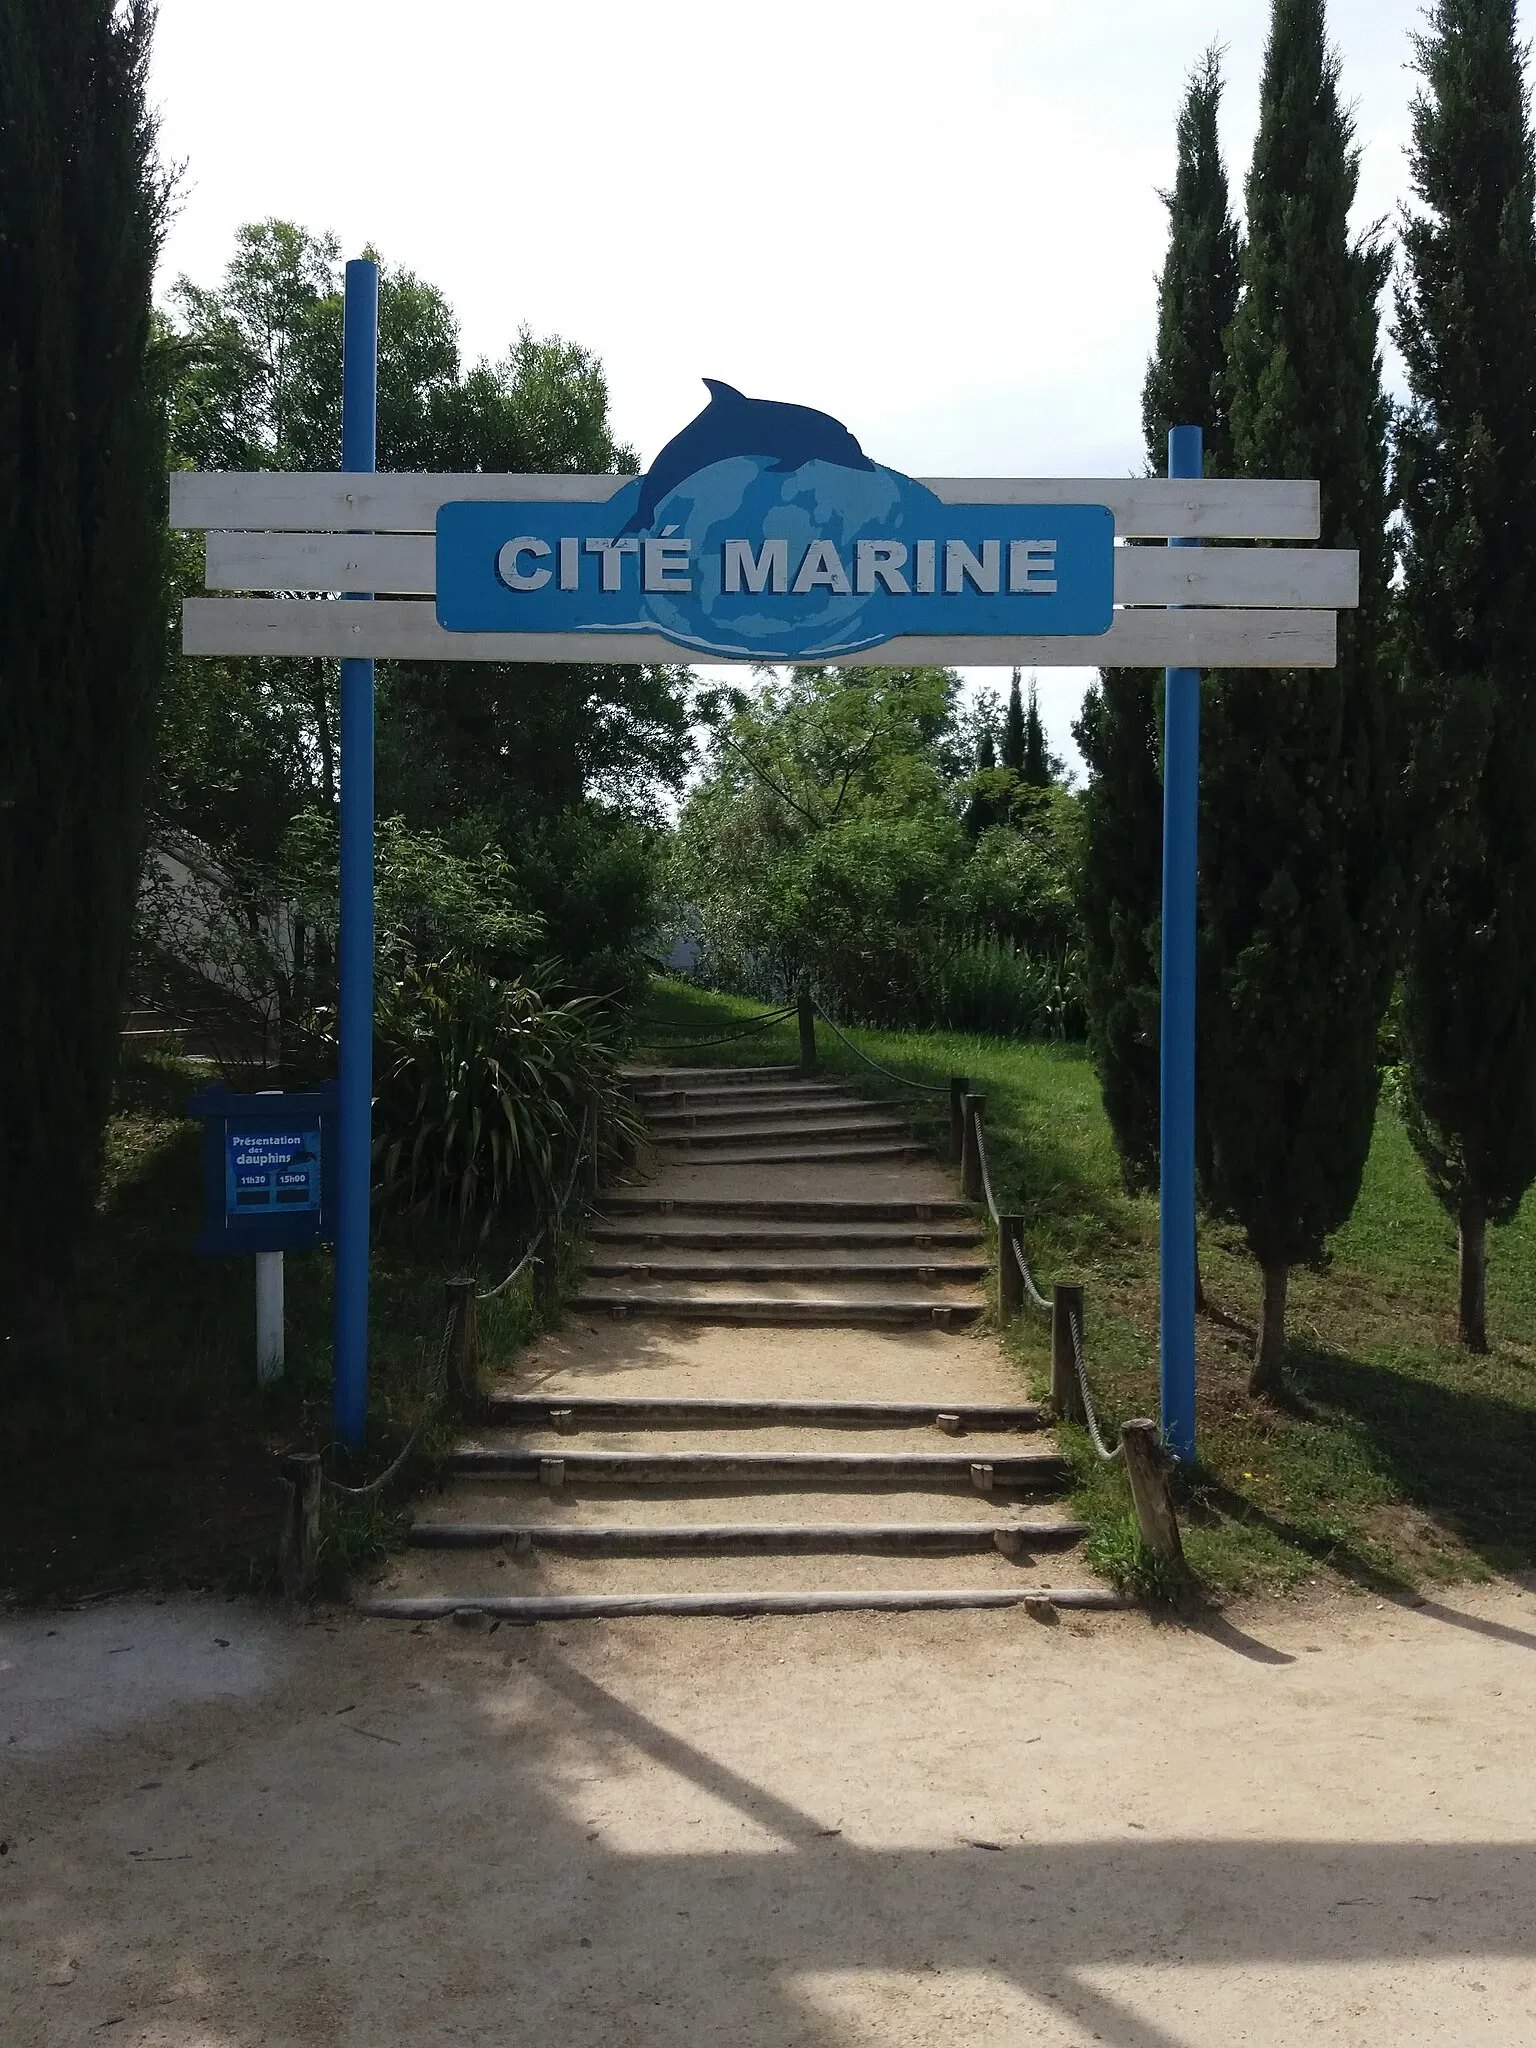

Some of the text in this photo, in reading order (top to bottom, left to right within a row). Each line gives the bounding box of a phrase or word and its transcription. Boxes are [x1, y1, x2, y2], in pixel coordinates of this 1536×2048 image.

[497, 525, 1057, 593] CITÉ MARINE
[233, 1136, 301, 1146] Présentation
[236, 1153, 291, 1166] dauphins
[241, 1175, 306, 1184] 11h30 15h00
